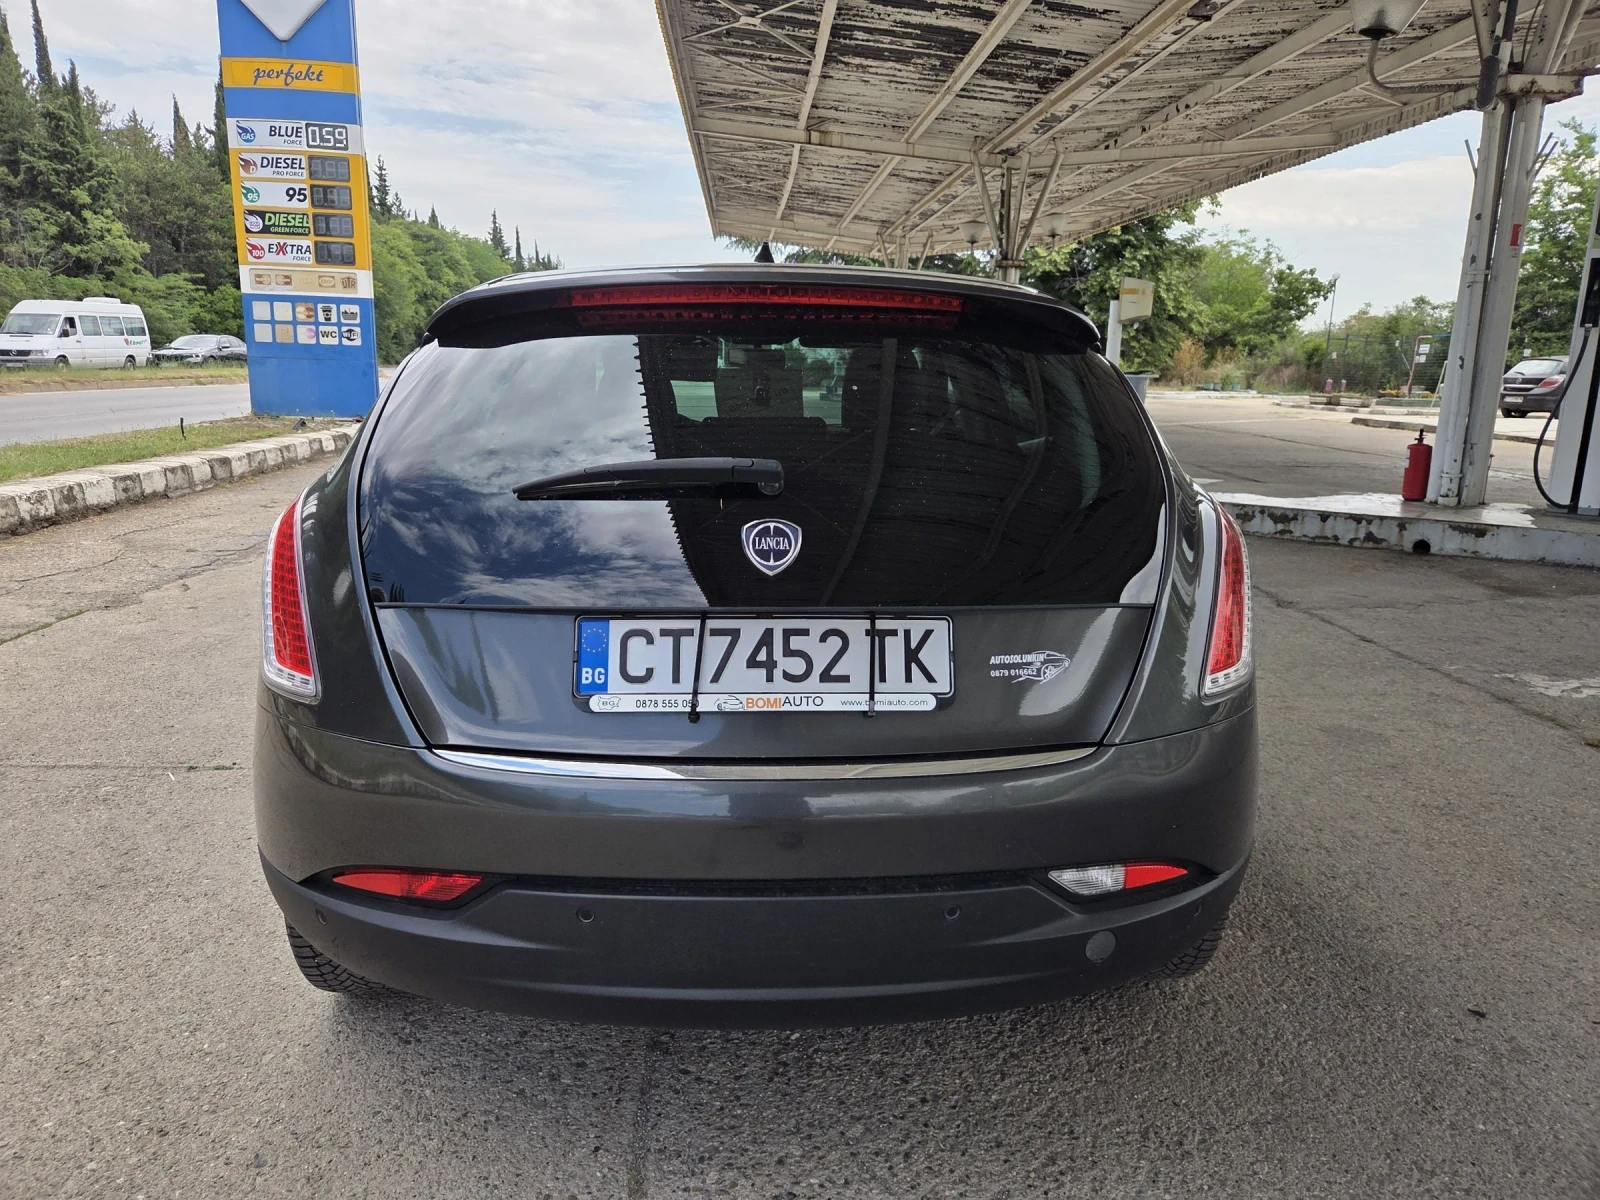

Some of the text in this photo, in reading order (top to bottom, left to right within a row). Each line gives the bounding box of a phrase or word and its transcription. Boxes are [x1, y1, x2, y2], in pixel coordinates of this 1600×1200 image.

[253, 64, 324, 87] perfekt
[241, 132, 255, 140] GAS
[269, 125, 303, 139] BLUE
[260, 156, 305, 170] DIESEL
[285, 170, 305, 178] FORCE
[247, 193, 258, 201] 95
[285, 187, 308, 203] 95
[264, 213, 310, 227] DIESEL
[251, 249, 265, 257] 100
[267, 242, 312, 256] EXTRA
[320, 331, 337, 339] WC
[755, 536, 790, 550] LANCIA
[619, 628, 938, 684] CT 7452 TK
[581, 667, 605, 684] BG
[635, 699, 659, 709] 0878
[661, 699, 679, 709] 555
[745, 695, 824, 709] BOMIAUTO
